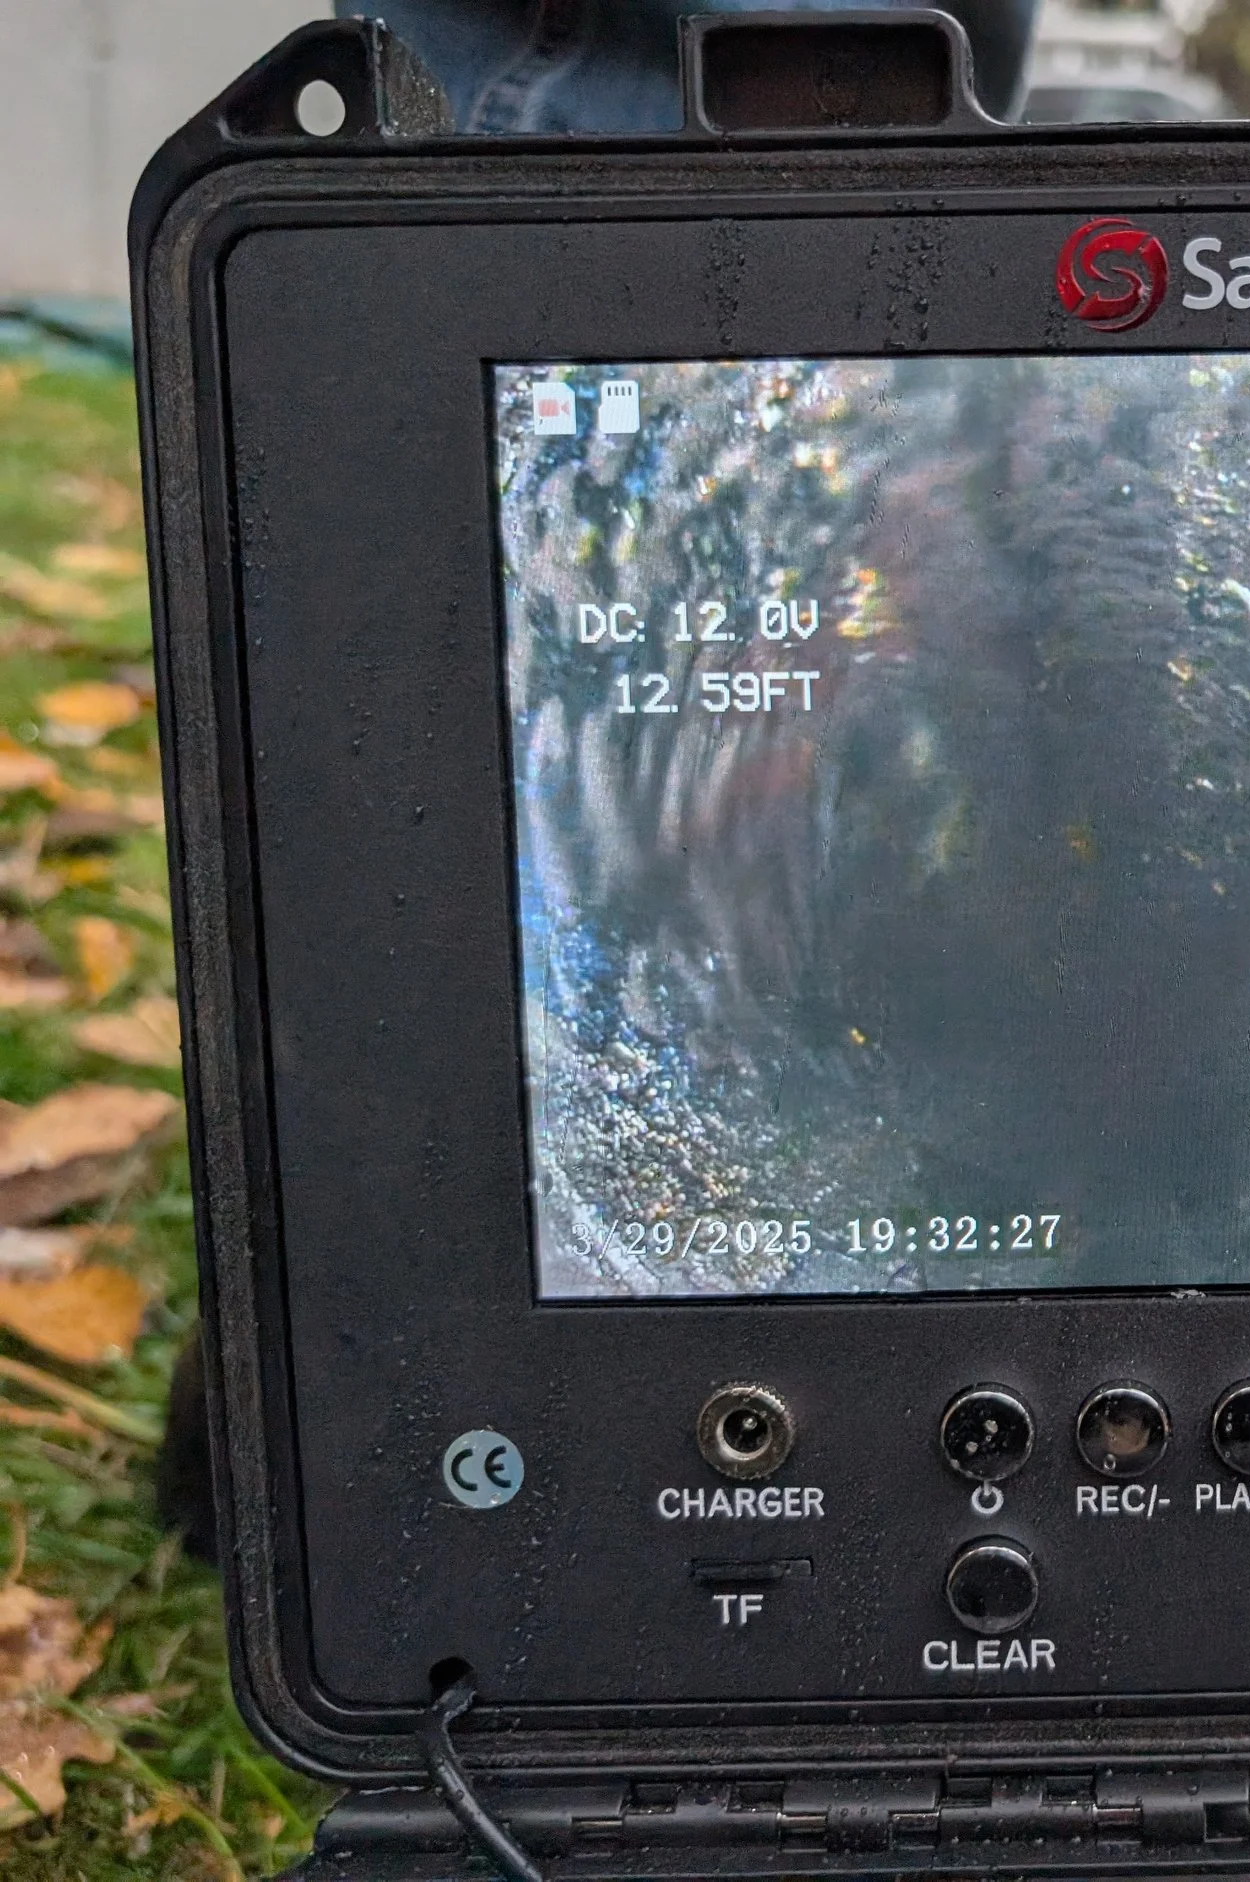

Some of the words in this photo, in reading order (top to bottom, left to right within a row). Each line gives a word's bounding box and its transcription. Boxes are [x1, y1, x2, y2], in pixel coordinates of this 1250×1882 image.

[846, 1214, 1062, 1253] 19:32:27
[450, 1445, 515, 1492] CE
[657, 1486, 826, 1520] CHARGER
[1075, 1483, 1171, 1520] REC/-
[712, 1594, 765, 1626] TF
[921, 1639, 1057, 1672] CLEAR
